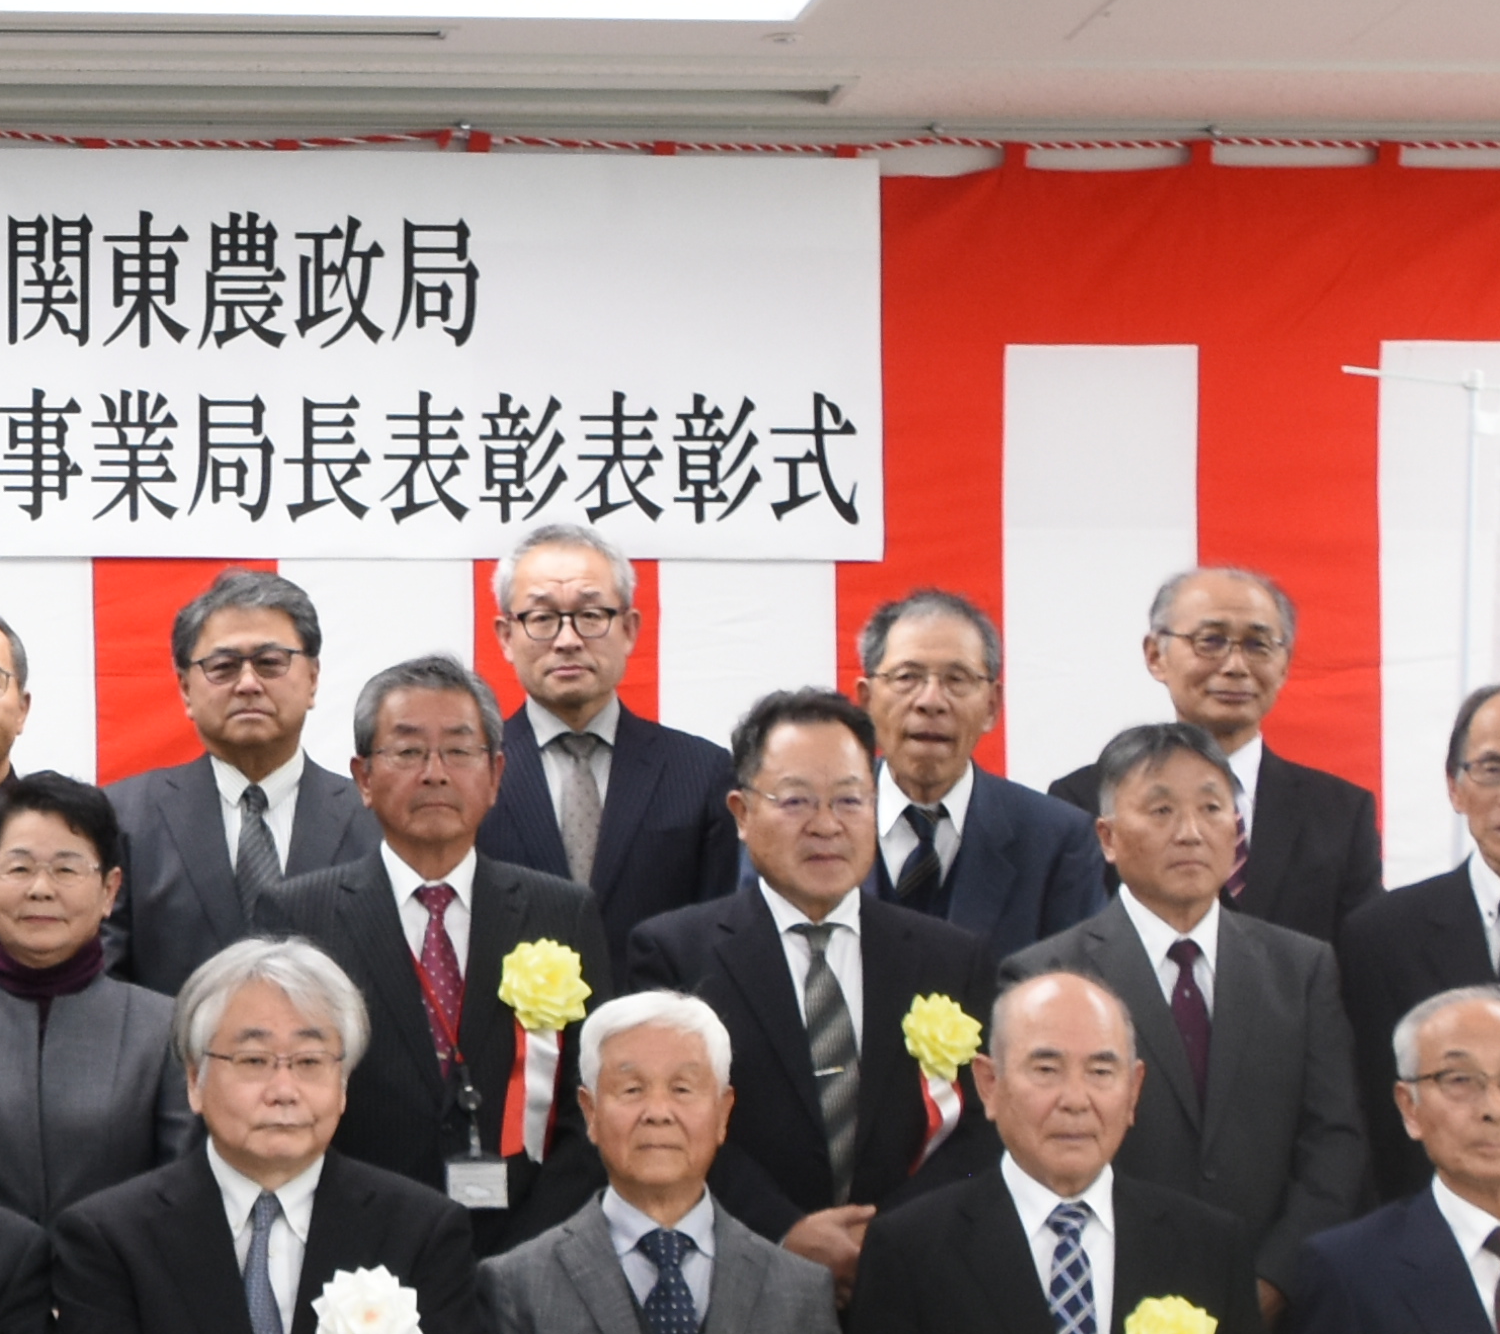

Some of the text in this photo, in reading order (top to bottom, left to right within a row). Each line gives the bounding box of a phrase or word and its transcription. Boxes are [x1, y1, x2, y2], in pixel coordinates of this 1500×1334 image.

[7, 209, 481, 350] 関東農政局
